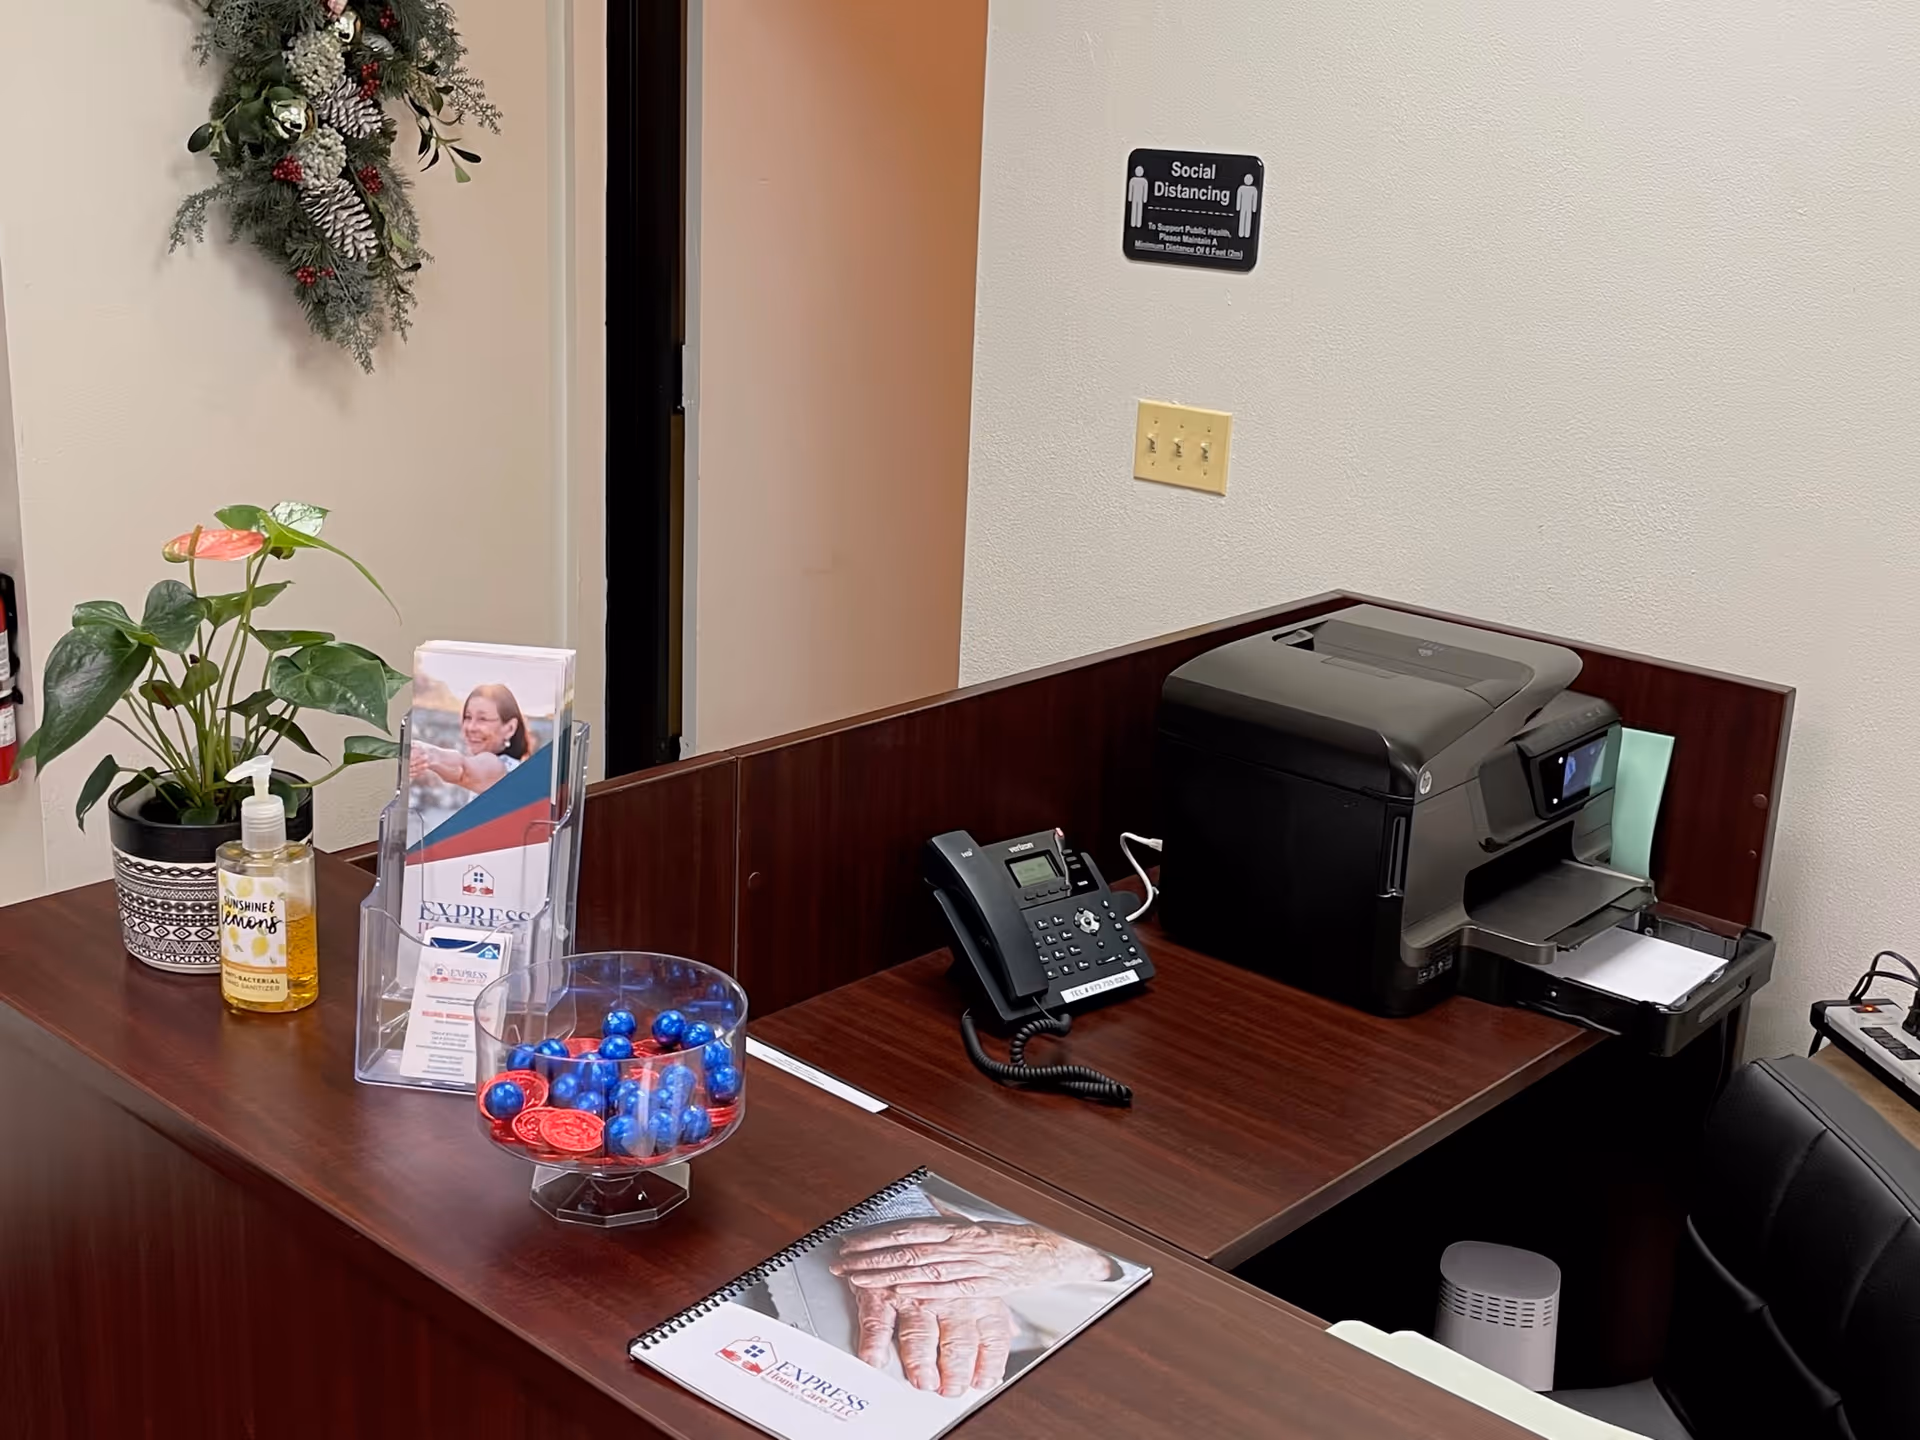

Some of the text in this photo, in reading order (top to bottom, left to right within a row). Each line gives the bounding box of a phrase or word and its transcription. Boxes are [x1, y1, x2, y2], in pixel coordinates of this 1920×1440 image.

[1171, 161, 1216, 180] Social
[1153, 181, 1231, 206] Distancing
[1148, 222, 1156, 230] To
[1157, 223, 1184, 234] Support
[1185, 225, 1206, 236] Public
[1159, 233, 1218, 246] Please Maintain A
[1135, 240, 1243, 259] Minimum Distance Of 6 Feet (2m)
[1008, 842, 1034, 853] verizon
[224, 895, 267, 913] SUNSHINE
[419, 900, 531, 928] EXPRESS
[450, 968, 488, 979] EXPRESS
[766, 1369, 858, 1416] Home Care LLC
[776, 1361, 869, 1411] EXPRESS
